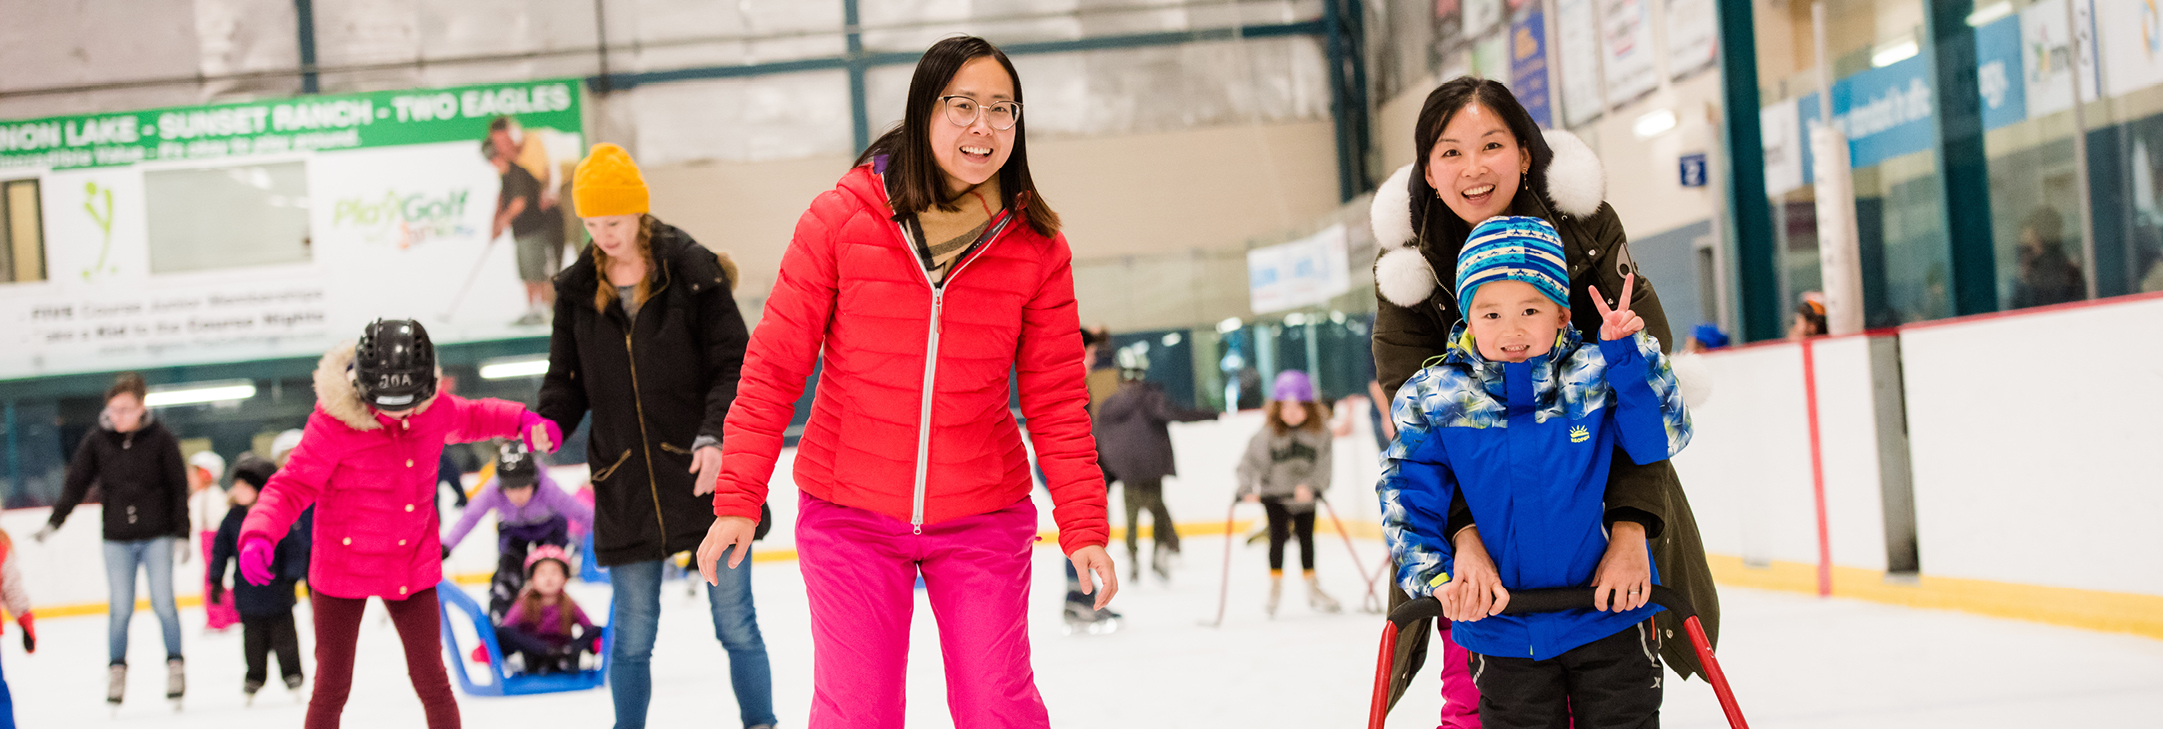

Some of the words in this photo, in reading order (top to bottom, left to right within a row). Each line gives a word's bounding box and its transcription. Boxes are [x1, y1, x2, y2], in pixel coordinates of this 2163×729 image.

[66, 116, 139, 146] LAKE
[158, 107, 268, 138] SUNSET
[272, 100, 373, 129] RANCH
[391, 94, 459, 121] TWO
[461, 87, 571, 117] EAGLES
[379, 373, 412, 389] 20A
